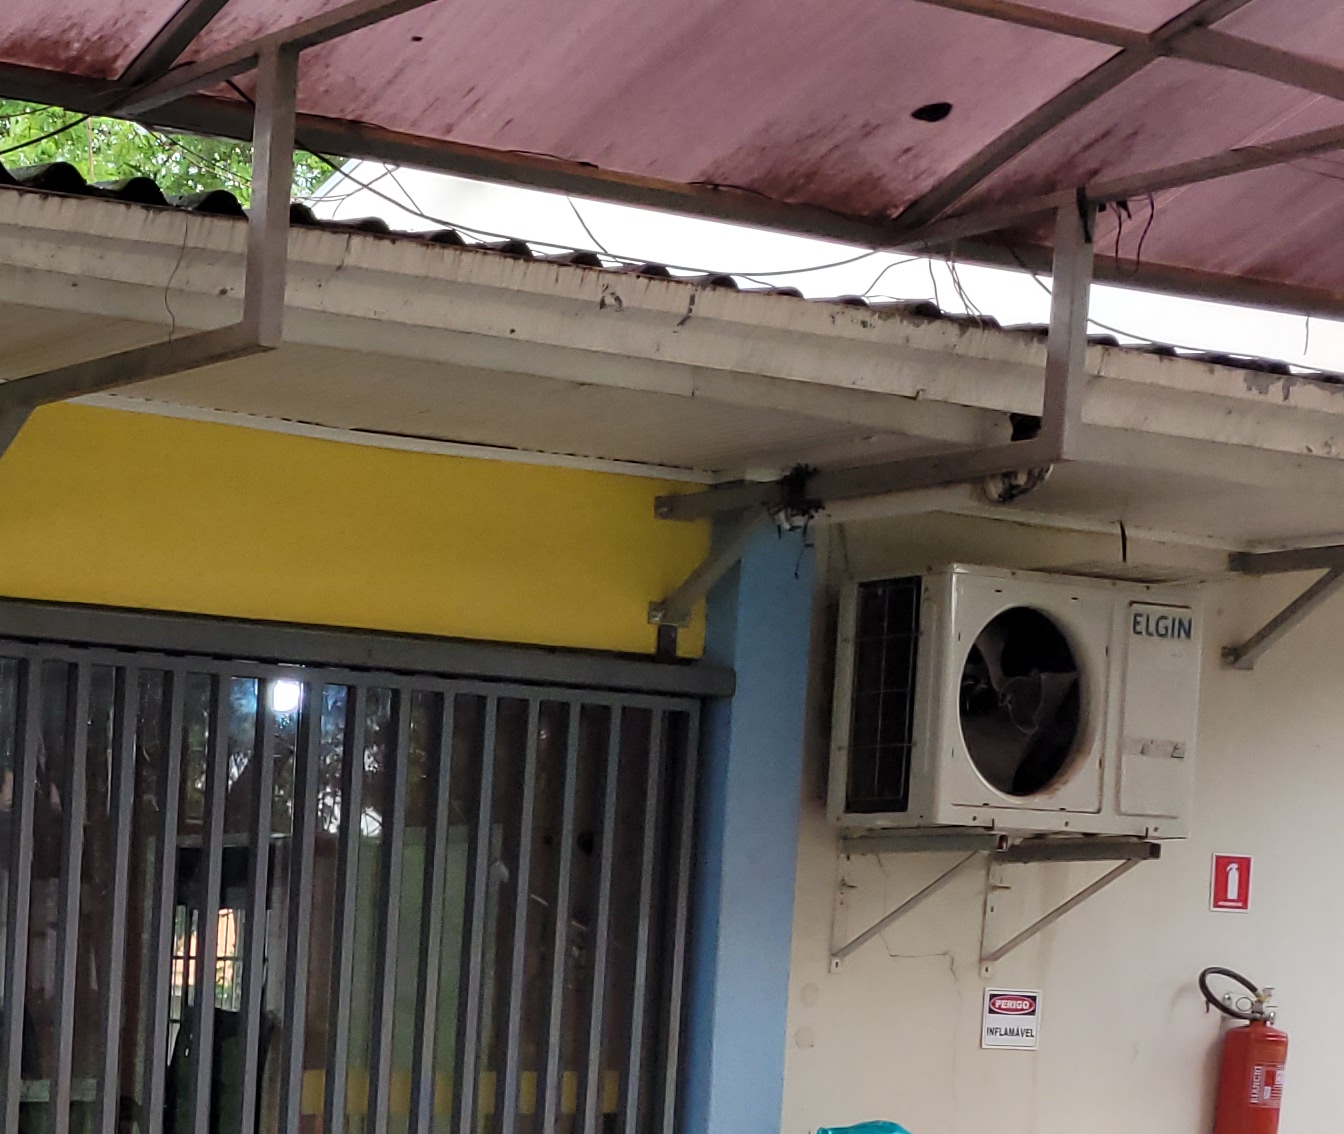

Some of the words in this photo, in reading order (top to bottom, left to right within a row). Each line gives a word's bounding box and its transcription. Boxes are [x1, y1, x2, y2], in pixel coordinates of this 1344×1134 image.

[1132, 613, 1193, 640] ELGIN
[995, 999, 1030, 1010] PERIGO
[986, 1026, 1034, 1038] INFLAMÁVEL
